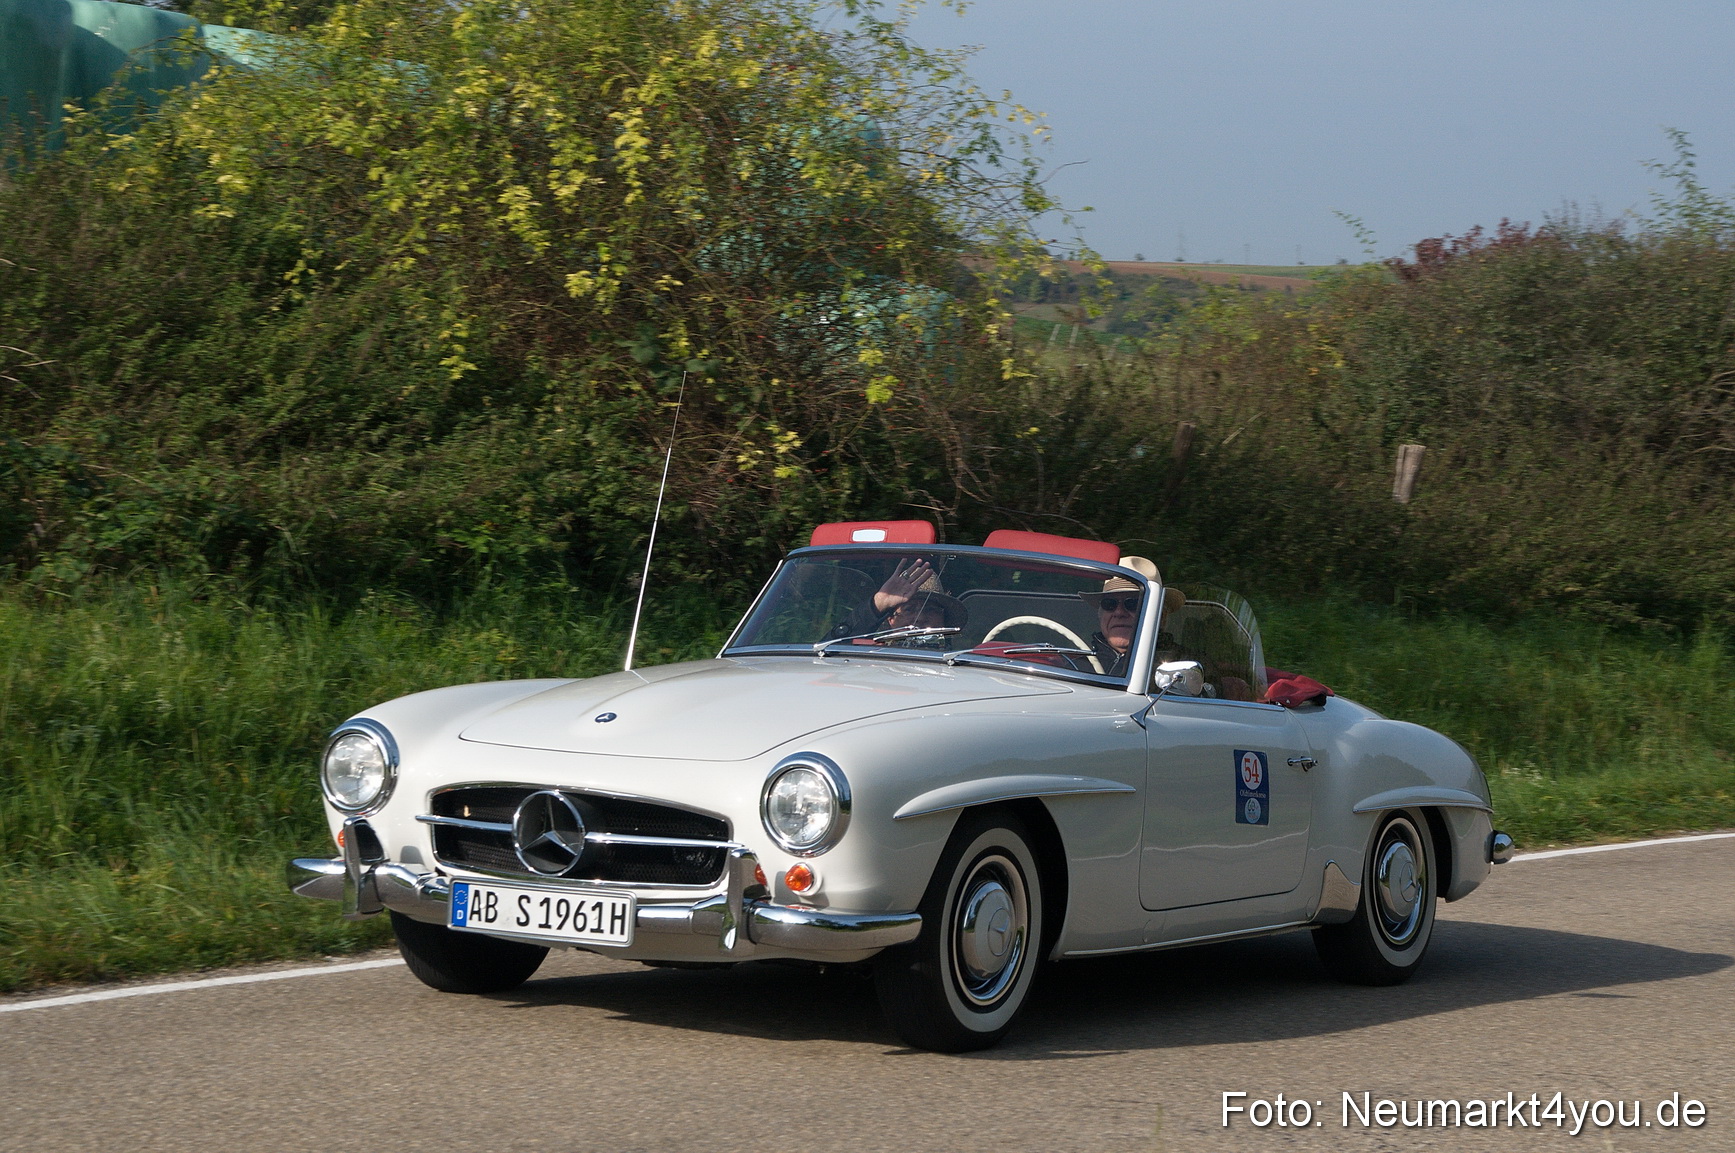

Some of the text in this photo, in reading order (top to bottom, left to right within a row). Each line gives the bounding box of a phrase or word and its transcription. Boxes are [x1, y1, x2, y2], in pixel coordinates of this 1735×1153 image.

[1244, 758, 1260, 783] 54
[457, 910, 464, 919] D
[469, 889, 498, 924] AB
